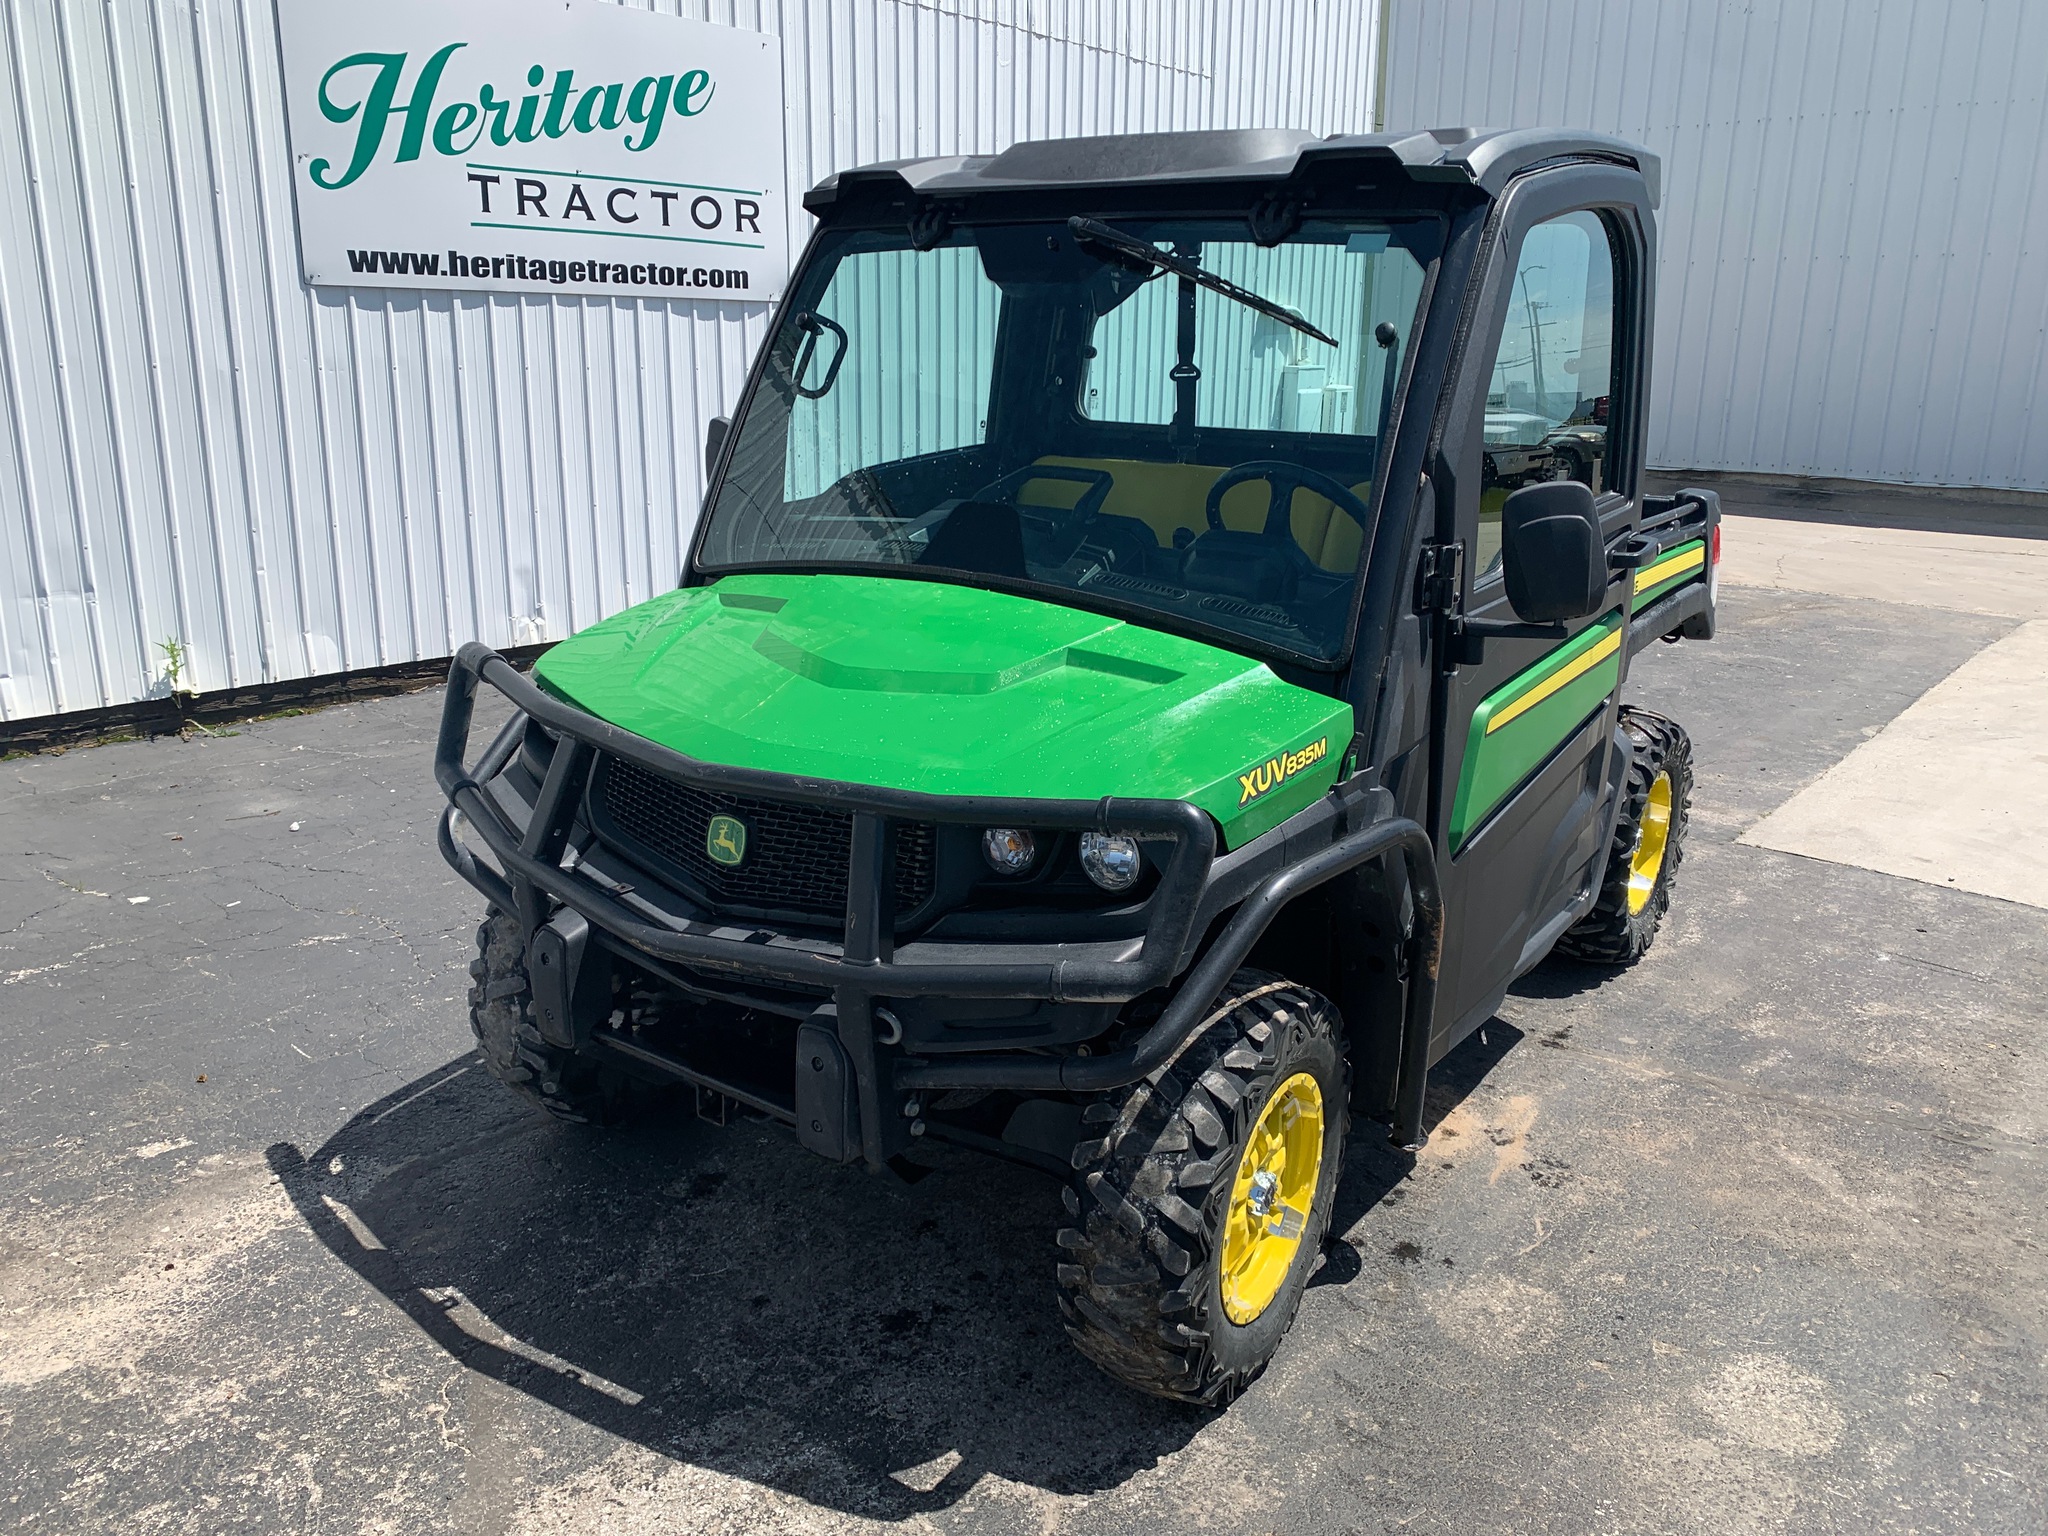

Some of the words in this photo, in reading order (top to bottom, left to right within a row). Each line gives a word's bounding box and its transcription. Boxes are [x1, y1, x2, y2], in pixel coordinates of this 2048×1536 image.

[309, 42, 716, 190] Heritage
[466, 172, 761, 234] TRACTOR
[346, 249, 749, 289] www.heritagetractor.com
[1239, 737, 1327, 804] XUV835M
